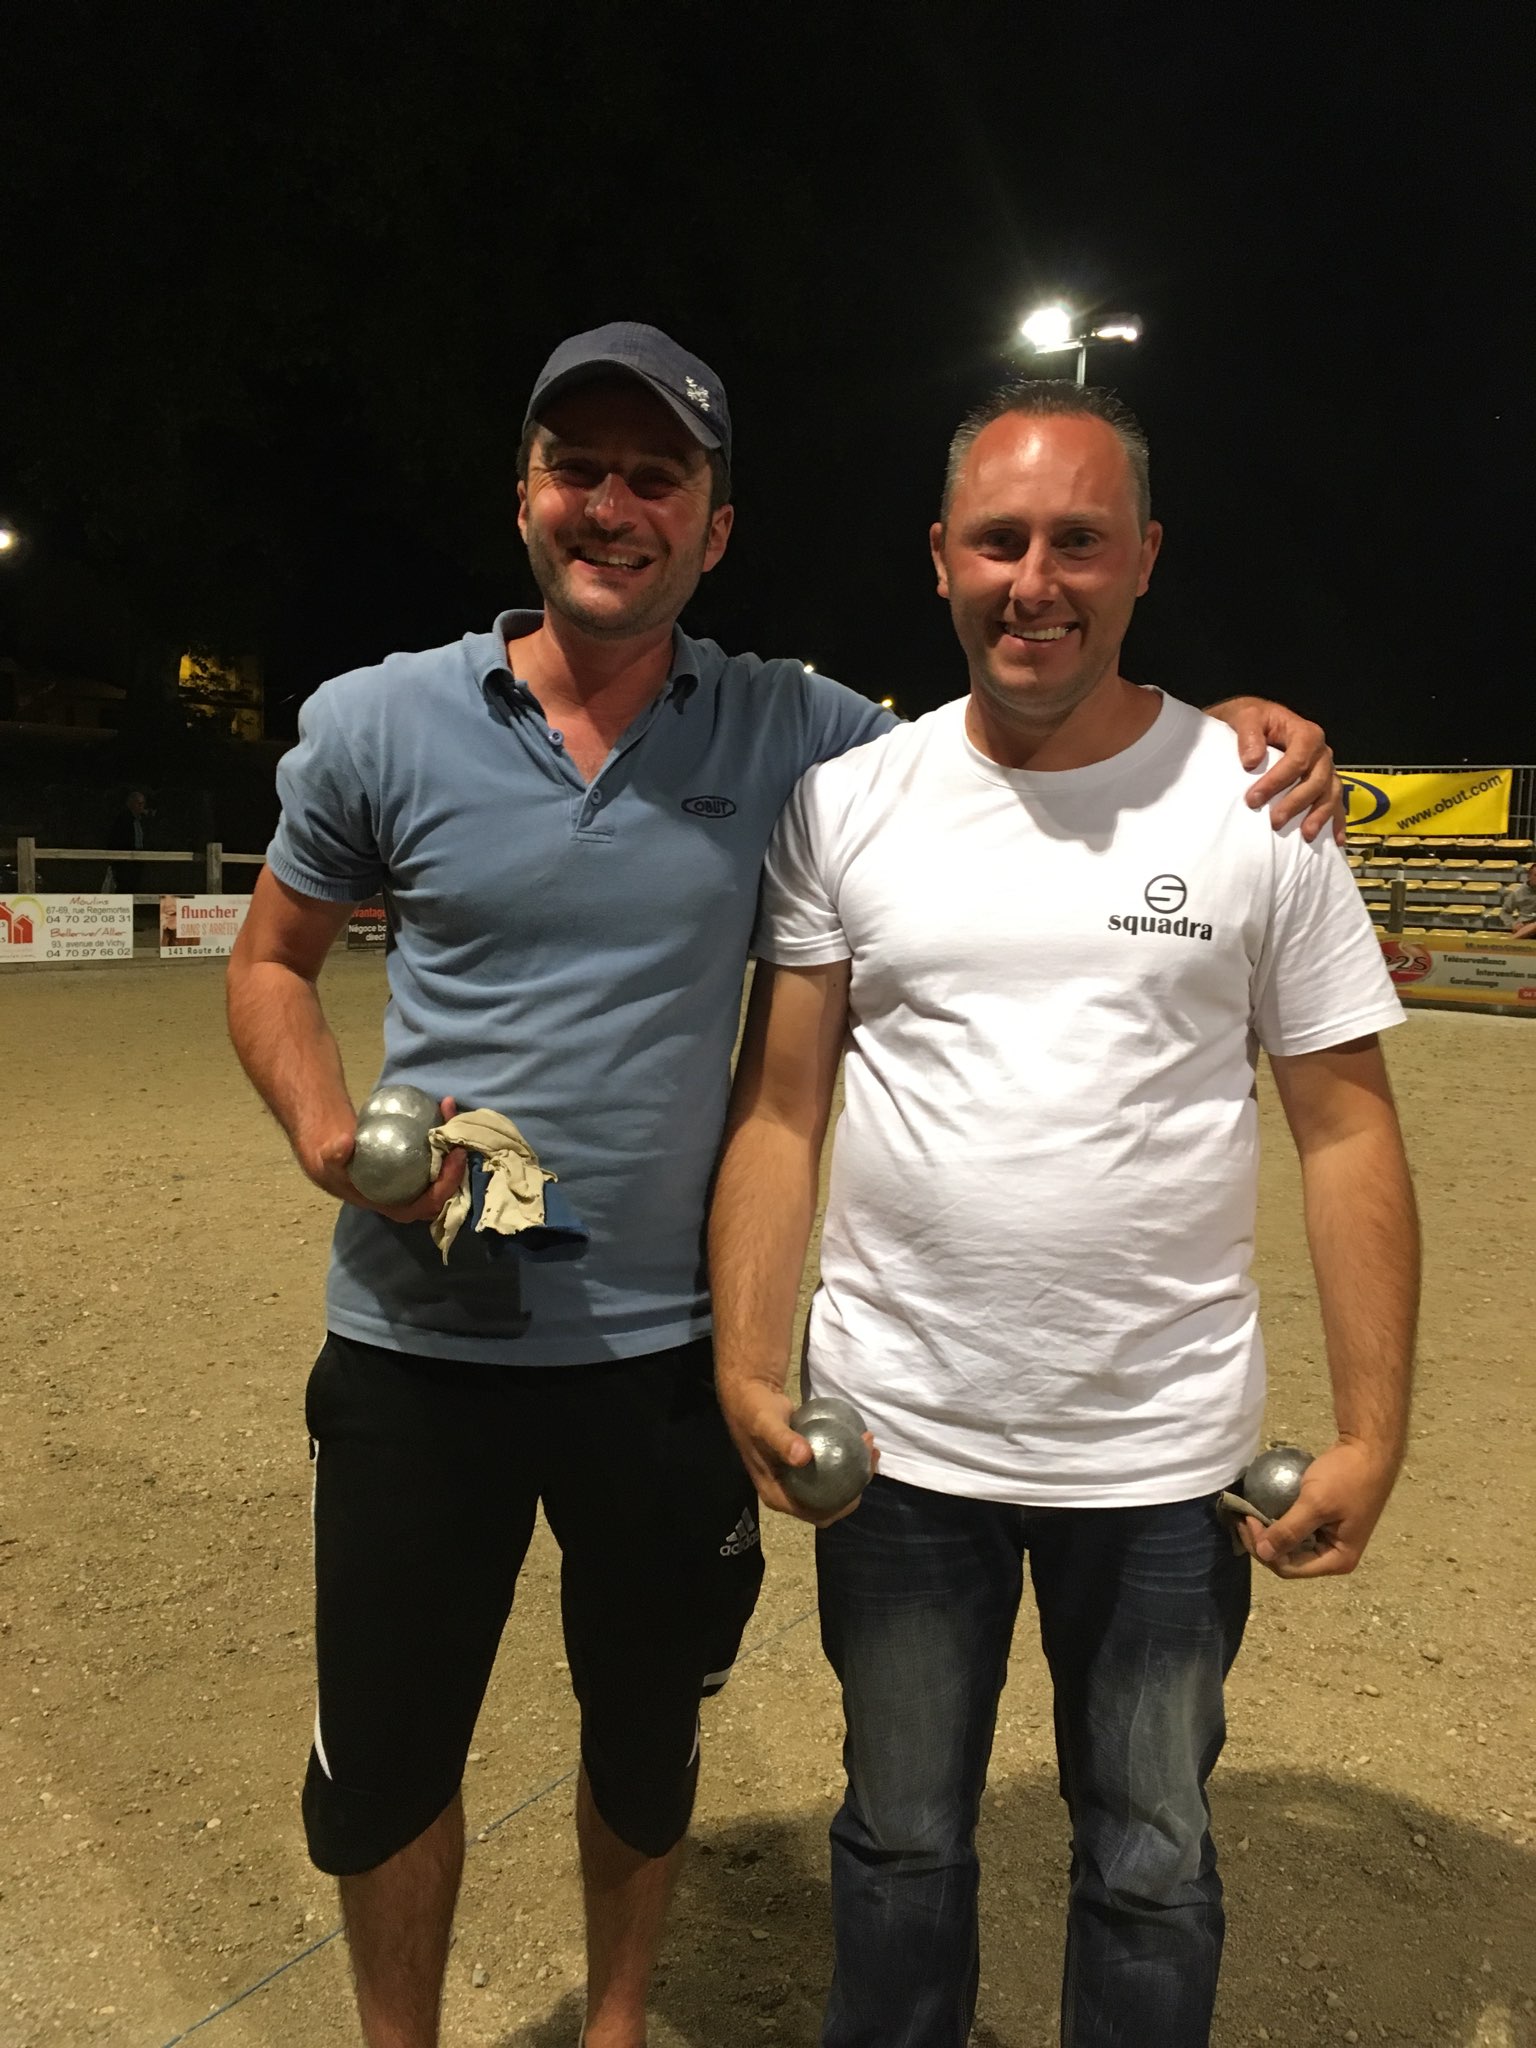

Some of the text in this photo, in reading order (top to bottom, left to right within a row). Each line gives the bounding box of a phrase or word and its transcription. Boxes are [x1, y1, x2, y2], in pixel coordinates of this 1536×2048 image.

[694, 800, 728, 813] OBUT
[1396, 774, 1503, 830] www.obut.com
[66, 915, 79, 923] 70
[84, 915, 98, 923] 20
[101, 915, 115, 923] 08
[119, 914, 131, 922] 31
[181, 905, 239, 919] fluncher
[180, 923, 200, 936] SANS
[1107, 914, 1213, 941] squadra
[106, 940, 125, 949] Vichy
[46, 950, 60, 958] 04
[66, 949, 79, 957] 70
[82, 949, 96, 957] 97
[100, 948, 114, 956] 66
[117, 948, 131, 956] 02
